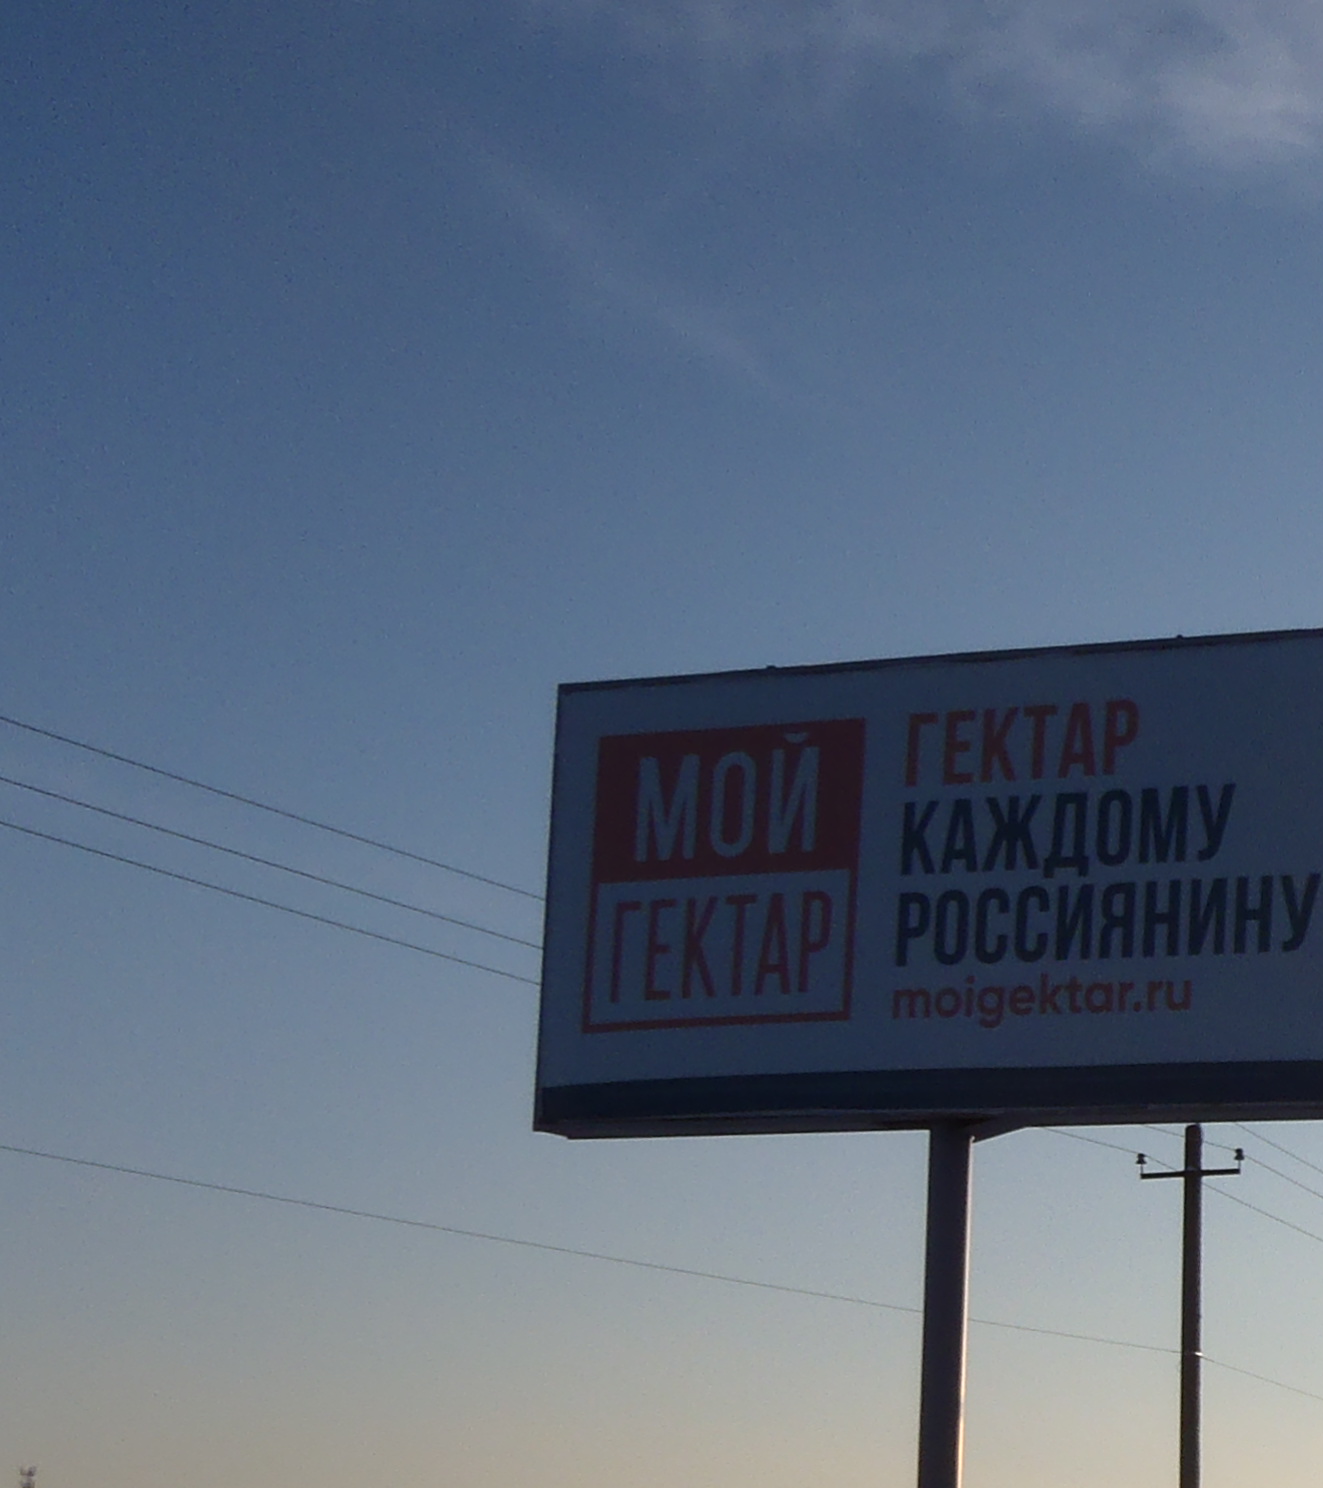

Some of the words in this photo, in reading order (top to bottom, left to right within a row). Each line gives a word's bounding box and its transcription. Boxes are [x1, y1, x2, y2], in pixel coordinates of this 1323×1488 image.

[904, 699, 1141, 786] ГЕКТАР
[634, 730, 820, 863] МОЙ
[899, 783, 1236, 879] КАЖДОМУ
[610, 888, 833, 1004] ГЕКТАР
[895, 872, 1321, 966] РОССИЯНИНУ
[892, 972, 1194, 1028] moigektar.ru
